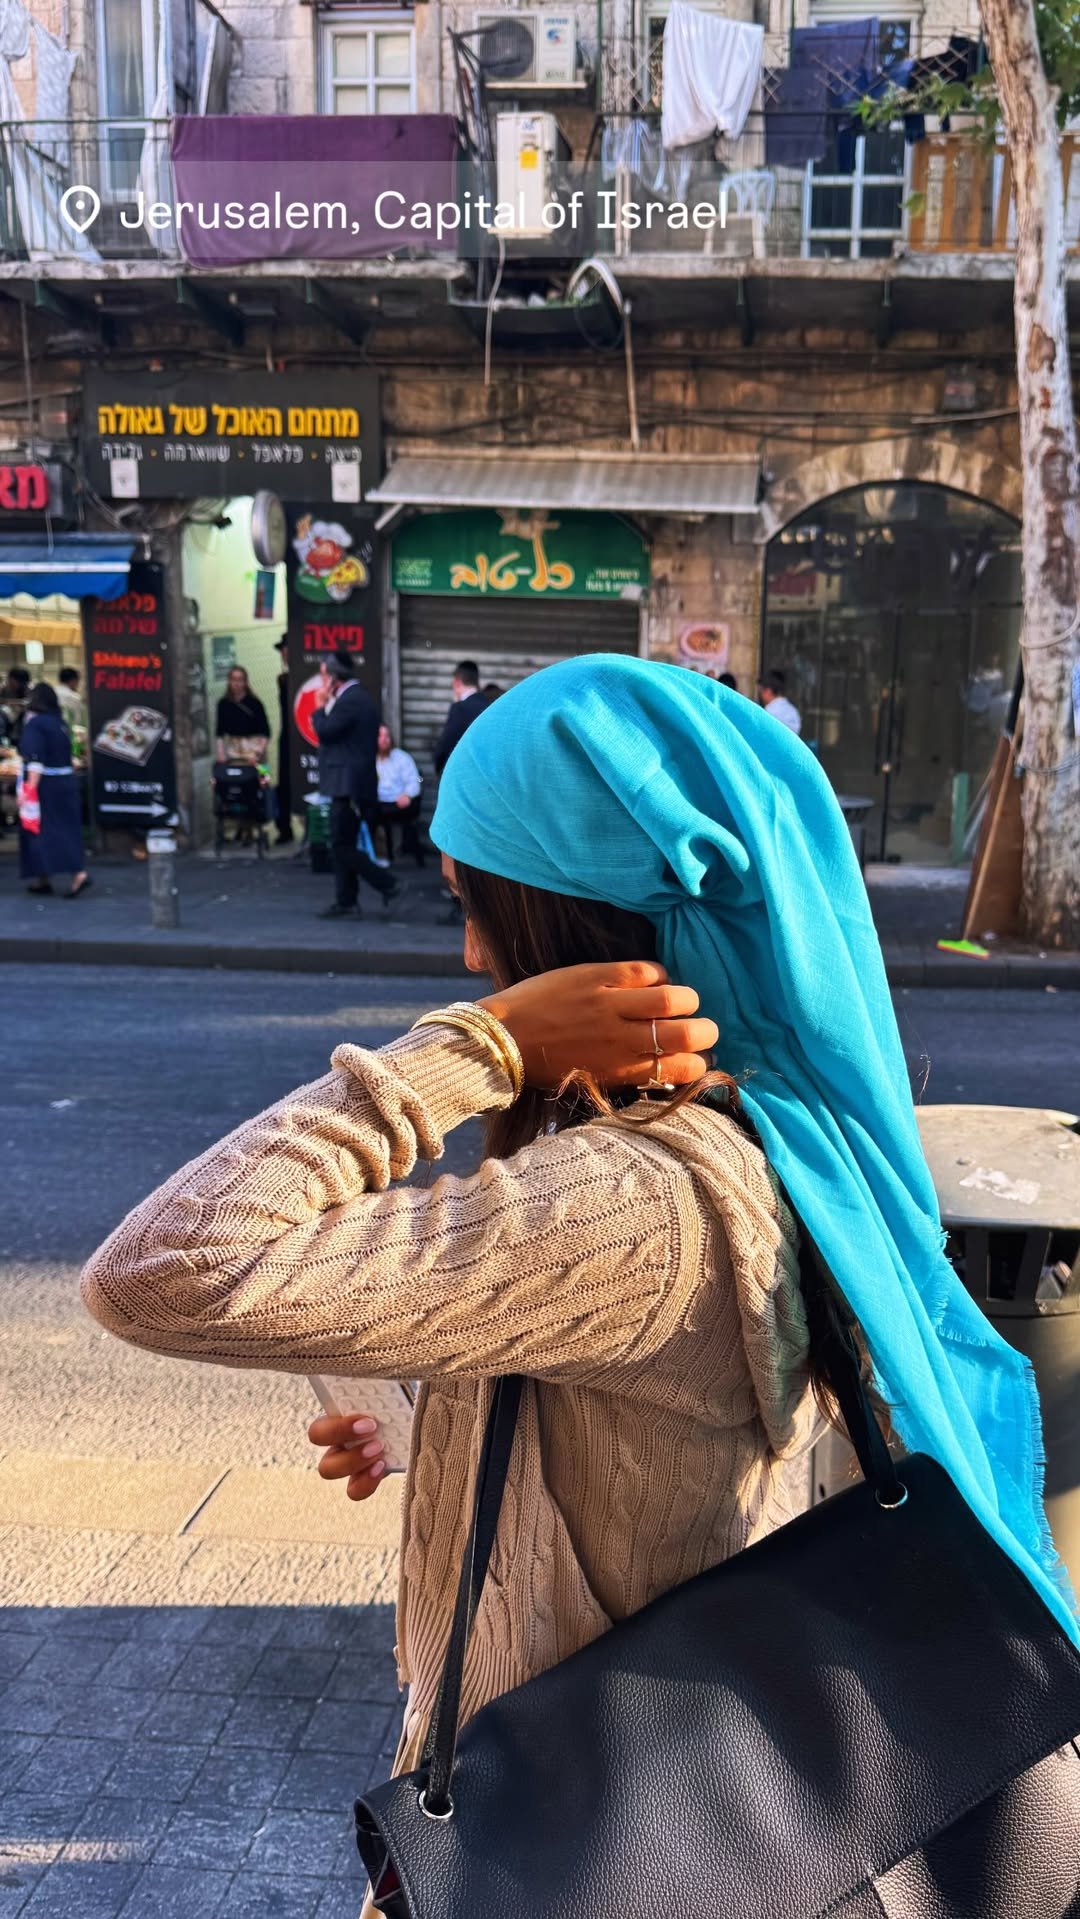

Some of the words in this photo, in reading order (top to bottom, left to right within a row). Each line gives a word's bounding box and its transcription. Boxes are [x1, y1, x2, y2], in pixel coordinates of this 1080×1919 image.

[98, 403, 164, 434] גאולה
[168, 404, 207, 436] של
[211, 403, 282, 436] האוכל
[288, 406, 359, 437] מתחם
[164, 443, 230, 462] שווארמה
[252, 443, 304, 463] פלאפל
[304, 624, 363, 651] פיצה
[93, 651, 161, 668] Shlomo's
[94, 671, 162, 691] Falafel
